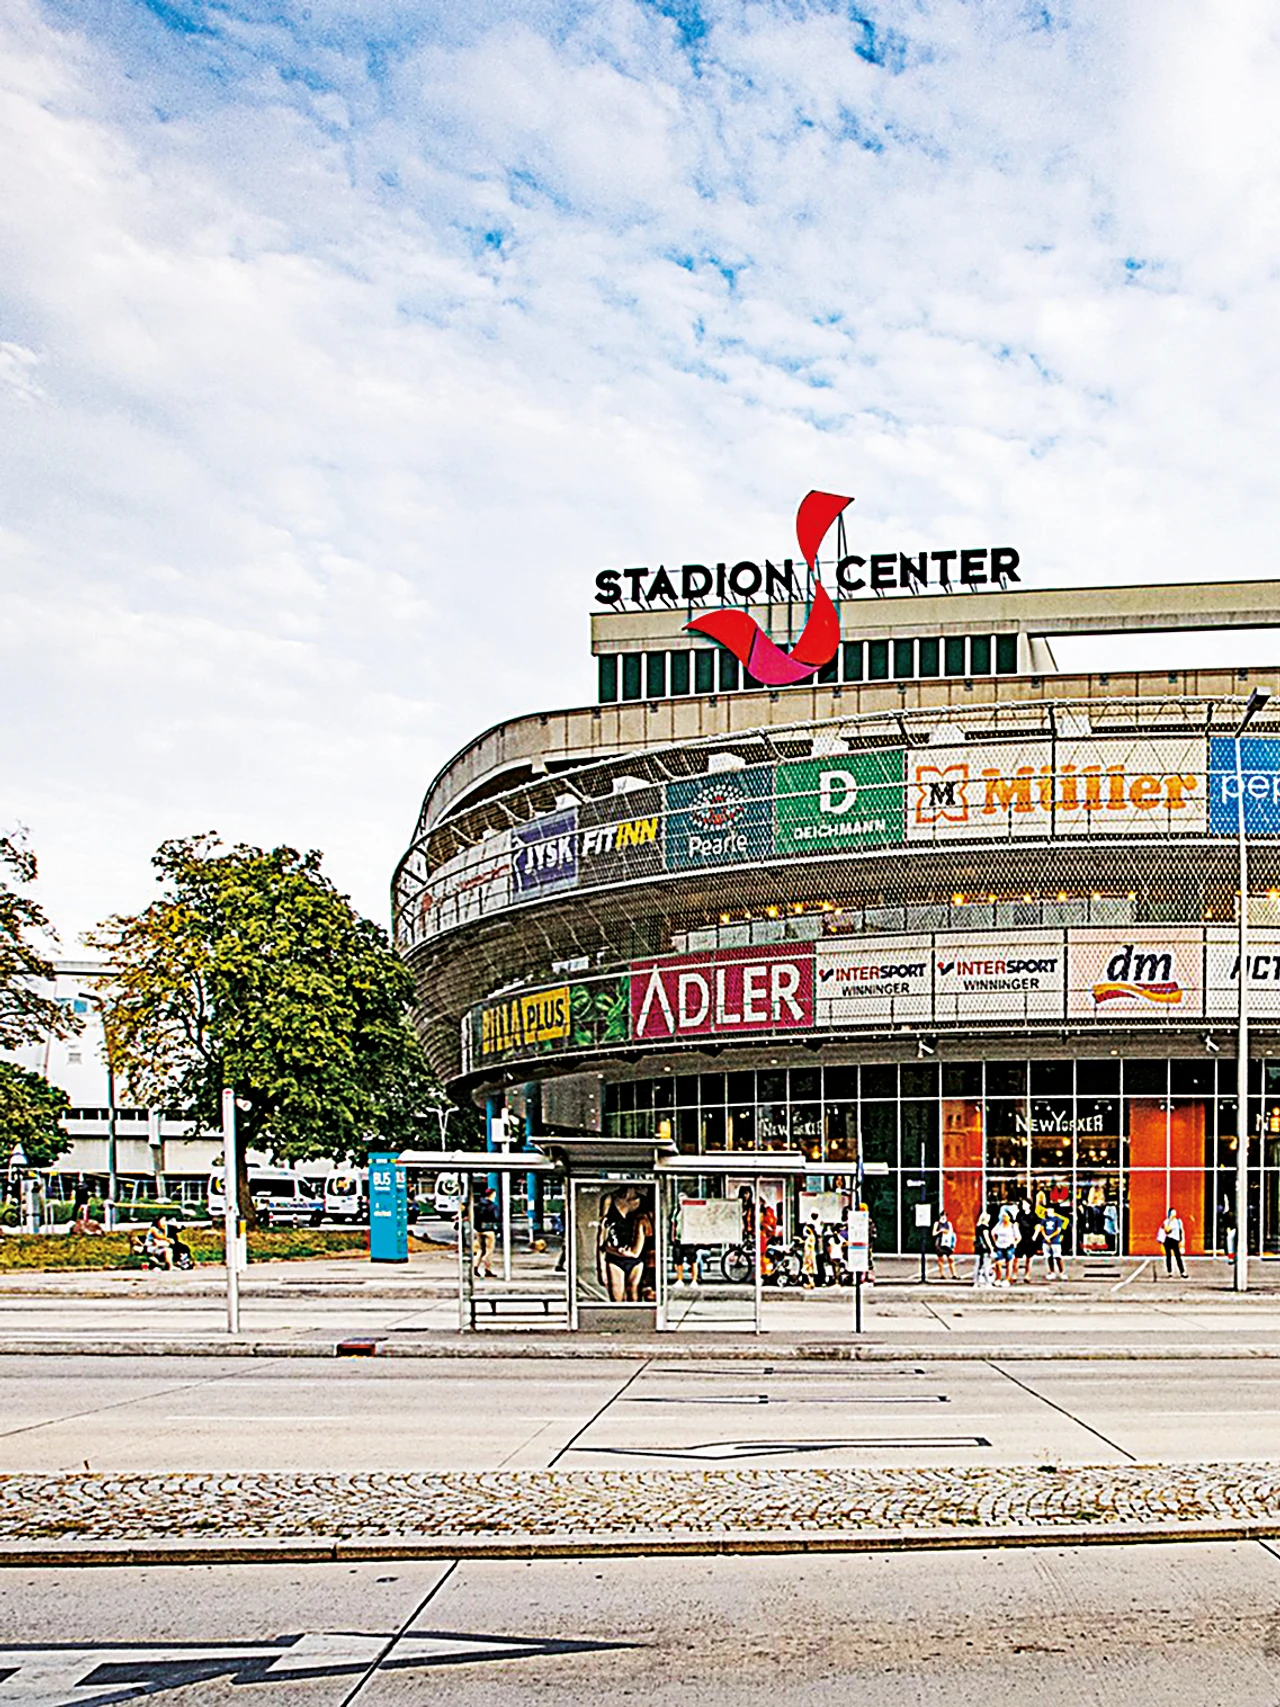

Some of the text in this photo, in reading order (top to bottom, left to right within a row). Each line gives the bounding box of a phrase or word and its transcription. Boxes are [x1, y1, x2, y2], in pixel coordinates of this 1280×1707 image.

[595, 547, 1021, 604] STADION CENTER
[819, 771, 857, 814] D
[981, 764, 1198, 814] Müller
[689, 831, 748, 857] Pearle
[794, 819, 886, 840] DEICHMANN
[525, 836, 573, 874] JYSK
[836, 963, 926, 981] INTERSPORT
[957, 959, 1058, 976] INTERSPORT
[1107, 944, 1172, 981] dm
[637, 963, 805, 1037] ADLER
[842, 982, 910, 996] WINNINGER
[964, 978, 1039, 991] WINNINGER
[527, 998, 564, 1033] PLUS
